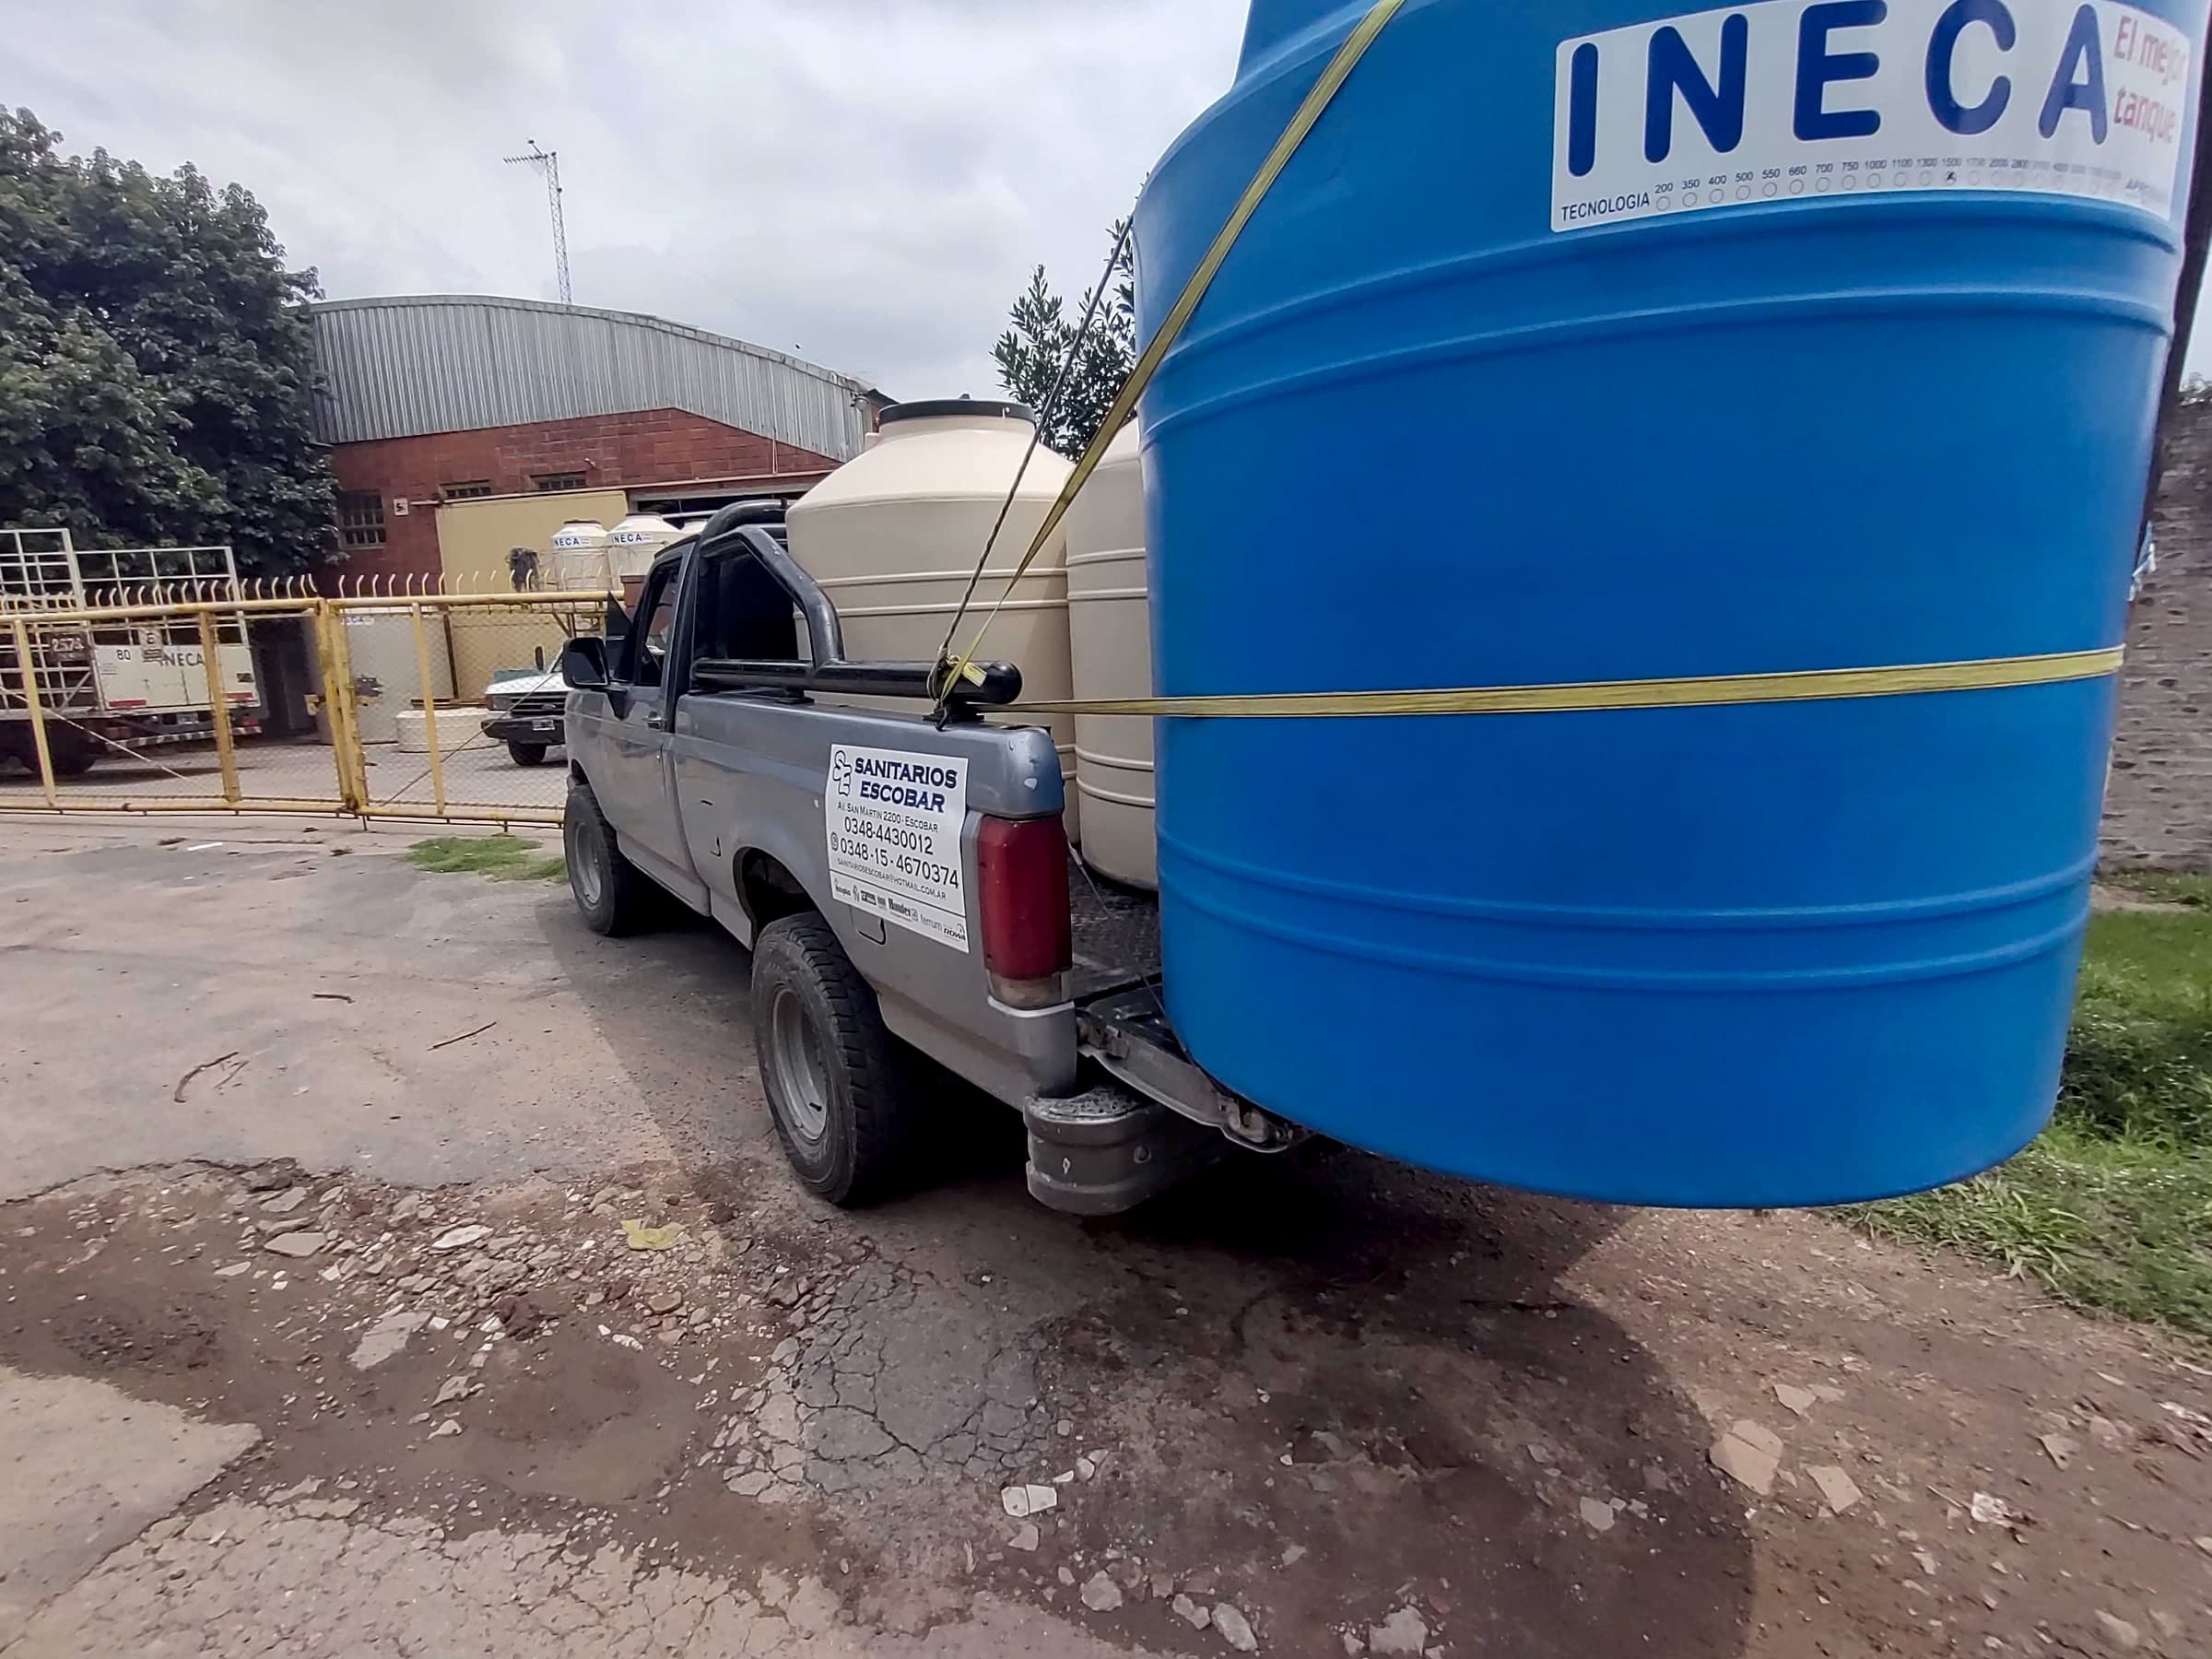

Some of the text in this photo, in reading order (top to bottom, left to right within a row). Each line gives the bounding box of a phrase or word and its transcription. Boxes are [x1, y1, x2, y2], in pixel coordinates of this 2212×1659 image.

[2113, 16, 2138, 62] El
[1567, 0, 2108, 177] INECA
[2113, 86, 2175, 144] tanque
[1654, 182, 1674, 194] 200
[1681, 178, 1700, 190] 350
[1708, 174, 1727, 185] 400
[1735, 171, 1754, 182] 500
[1761, 168, 1781, 179] 550
[1788, 165, 1807, 176] 660
[1816, 162, 1834, 173] 700
[1842, 160, 1859, 171] 750
[1864, 159, 1888, 171] 1000
[1891, 158, 1914, 169] 1100
[1916, 157, 1938, 168] 1300
[1941, 157, 1962, 168] 1500
[1560, 192, 1651, 222] TECNOLOGIA
[853, 757, 959, 789] SANITARIOS
[859, 780, 946, 813] ESCOBAR
[883, 811, 901, 824] 2200
